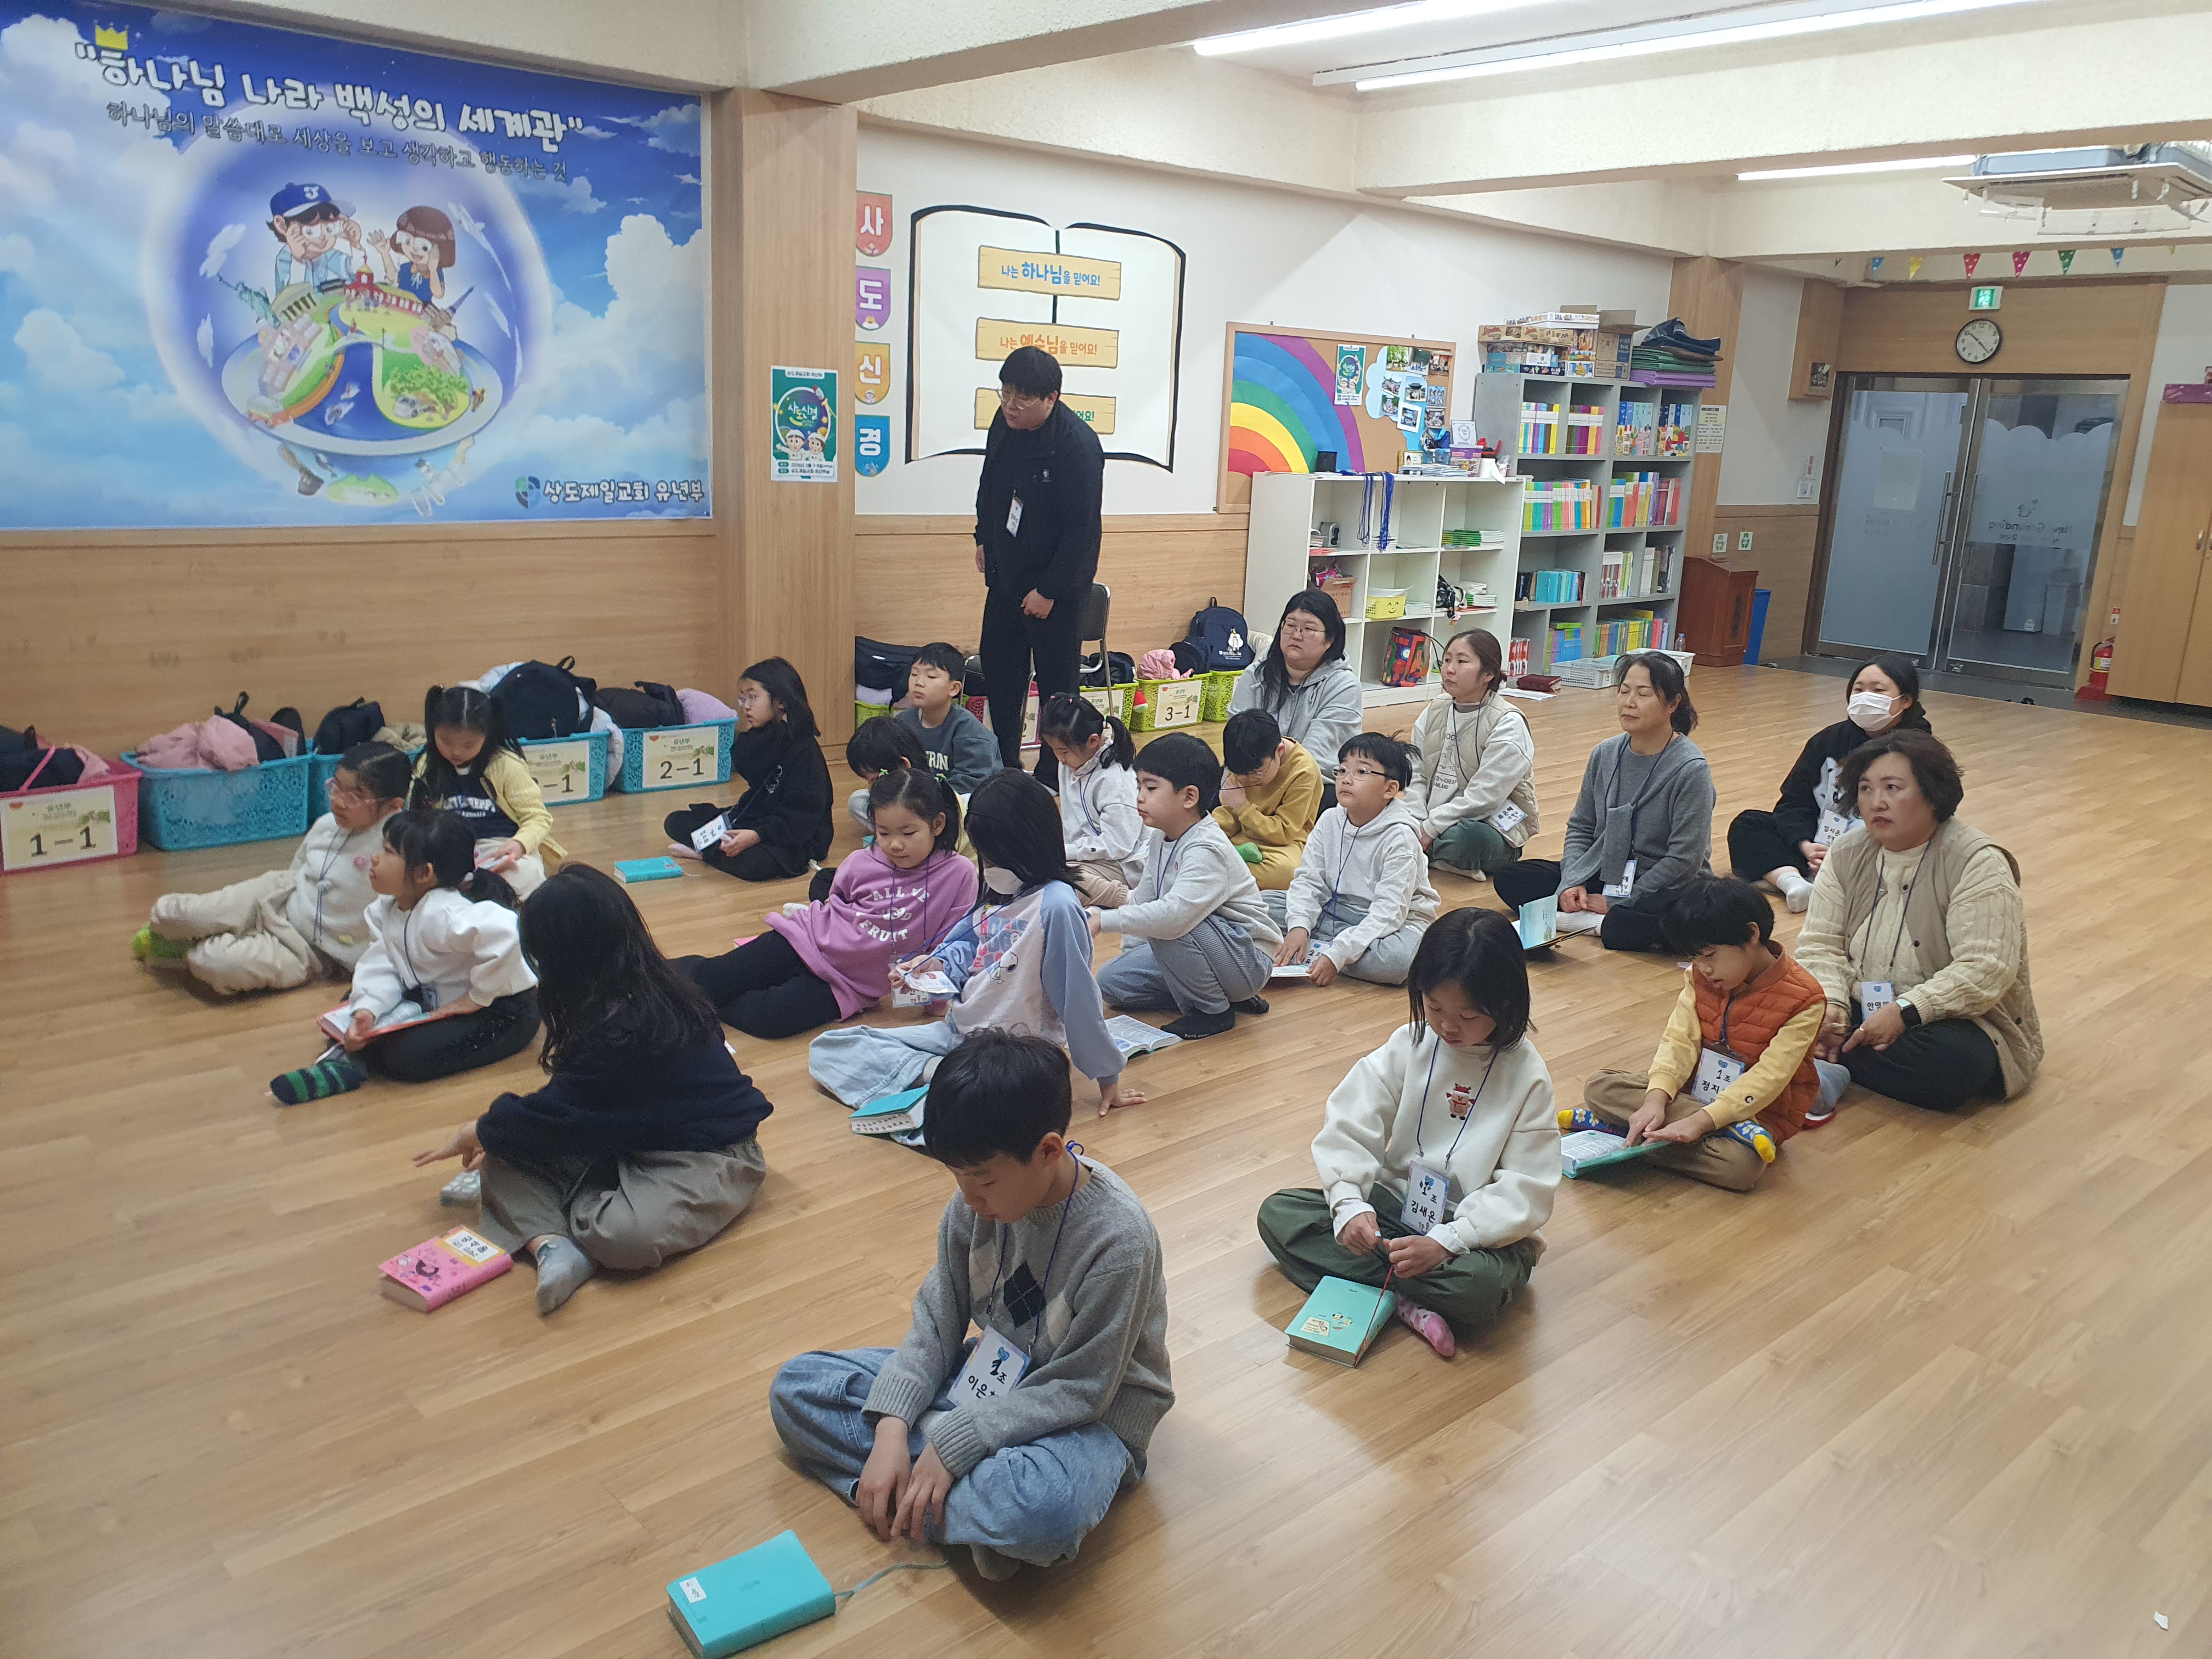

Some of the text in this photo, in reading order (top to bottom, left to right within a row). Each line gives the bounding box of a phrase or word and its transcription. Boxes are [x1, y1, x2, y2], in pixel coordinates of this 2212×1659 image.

[241, 72, 325, 111] 나라
[333, 82, 446, 132] 백성의
[106, 100, 568, 183] 하나님의 말씀대로 세상을 보고 생각하고 행동하는 것
[860, 206, 884, 236] 사
[1001, 261, 1101, 286] 나는 하나님을 믿어요!
[860, 279, 882, 310] 도
[1000, 337, 1017, 350] 나는
[1070, 342, 1097, 355] 믿어요!
[860, 355, 882, 384] 신
[788, 401, 817, 420] 사도신경
[859, 428, 881, 456] 경
[543, 479, 705, 504] 상도제일교회 유년부
[1165, 704, 1190, 721] 3-1
[660, 758, 704, 779] 2-1
[531, 774, 573, 793] -1
[30, 826, 97, 857] 1-1
[873, 886, 905, 901] ALL
[860, 919, 907, 943] FRUIT
[1702, 1080, 1725, 1094] 정지
[1745, 1095, 1754, 1104] C
[1411, 1200, 1435, 1224] 김새온
[968, 1375, 998, 1399] 이은
